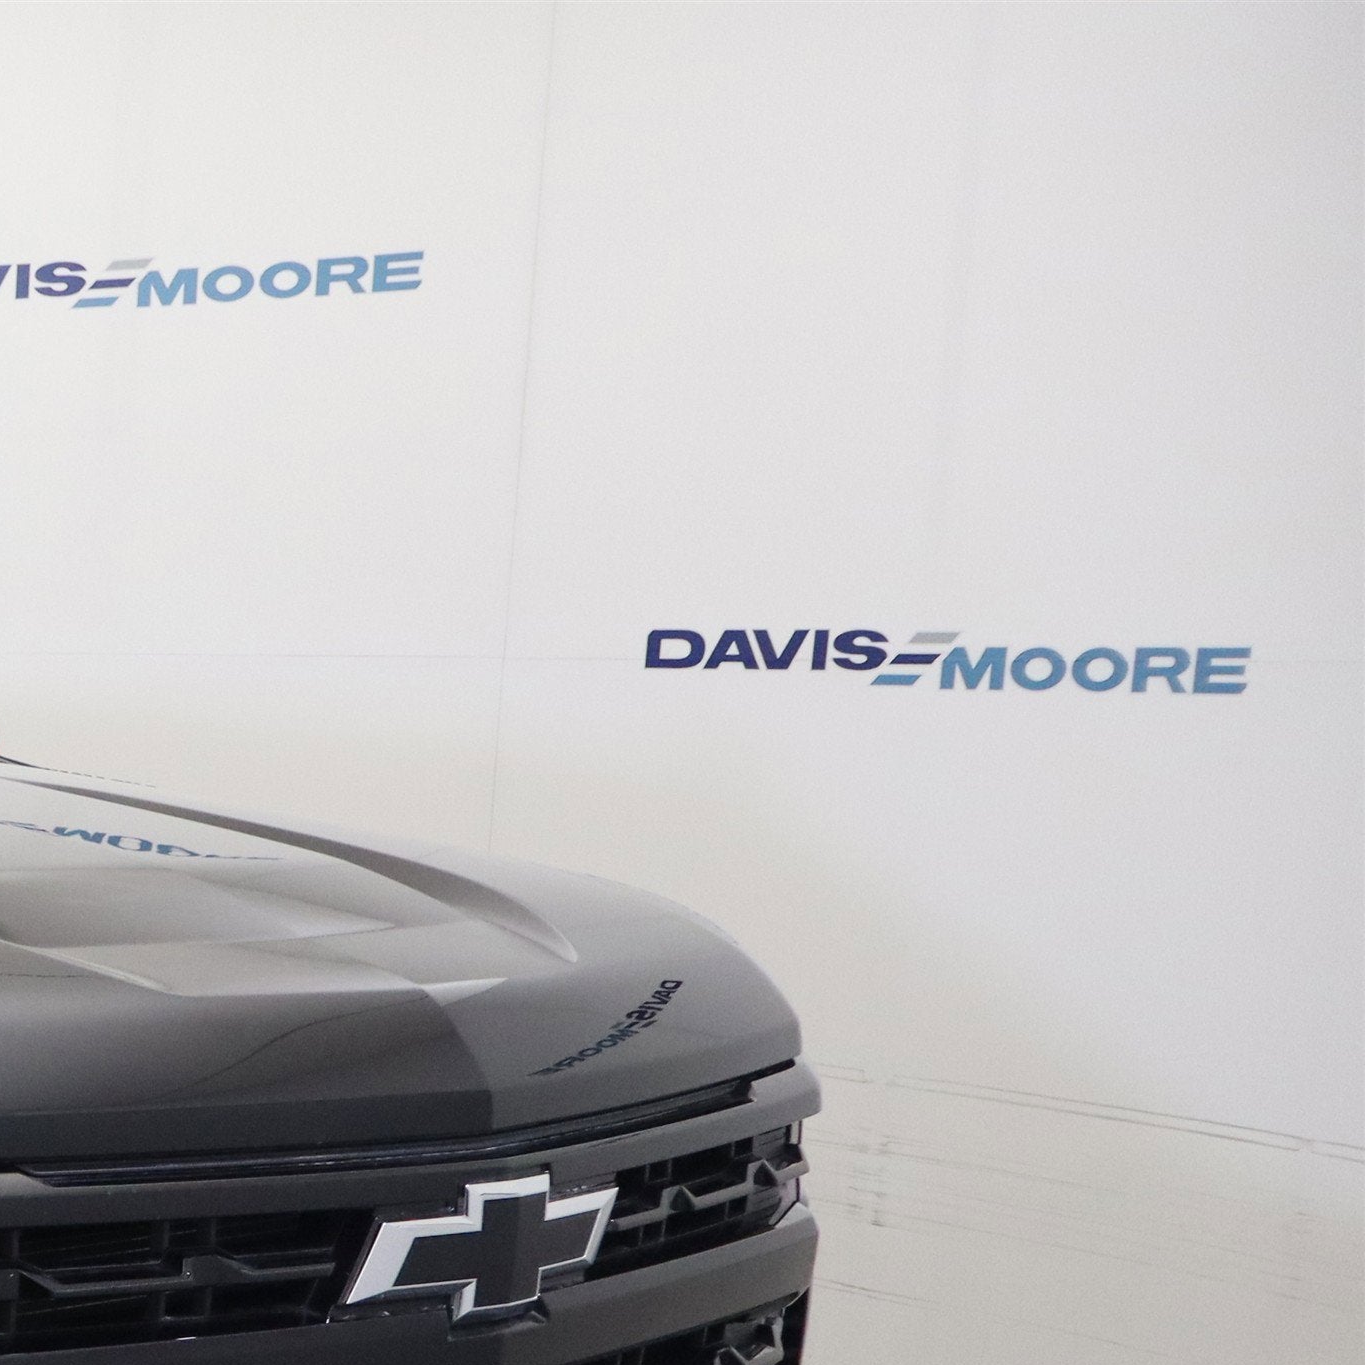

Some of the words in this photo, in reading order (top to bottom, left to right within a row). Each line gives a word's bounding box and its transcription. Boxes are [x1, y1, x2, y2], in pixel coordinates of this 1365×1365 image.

[136, 250, 425, 308] MOORE
[644, 628, 889, 672] DAVIS
[939, 646, 1253, 695] MOORE
